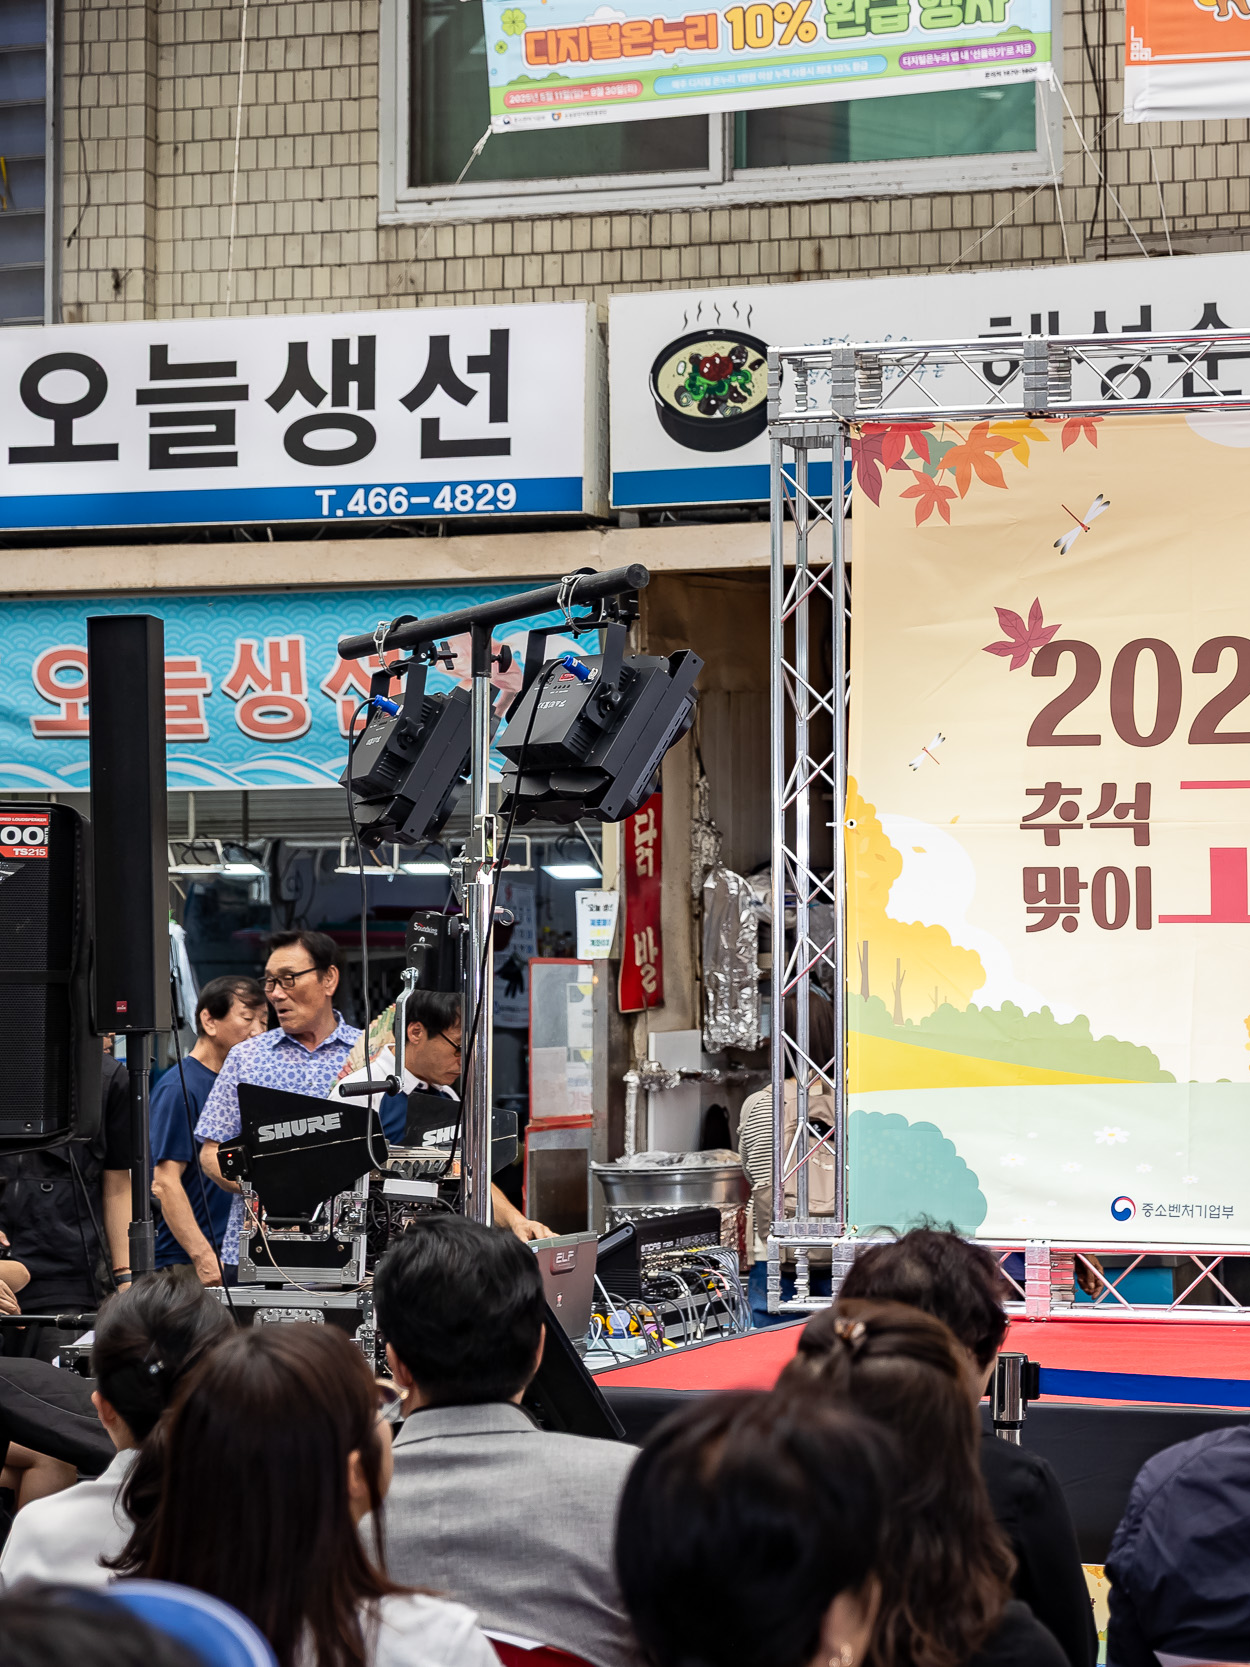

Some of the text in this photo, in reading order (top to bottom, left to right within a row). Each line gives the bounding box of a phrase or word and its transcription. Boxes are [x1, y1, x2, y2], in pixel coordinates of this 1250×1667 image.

[525, 14, 718, 66] 디지털온누리
[724, 1, 818, 50] 10%
[8, 328, 512, 470] 오늘생선
[314, 482, 517, 518] T.466-4829
[1020, 781, 1152, 847] 추석
[13, 848, 46, 856] TS215
[1023, 865, 1153, 934] 맞이
[258, 1112, 341, 1143] SHURE
[1142, 1203, 1234, 1220] 중소벤처기업부
[556, 1251, 574, 1264] ELF
